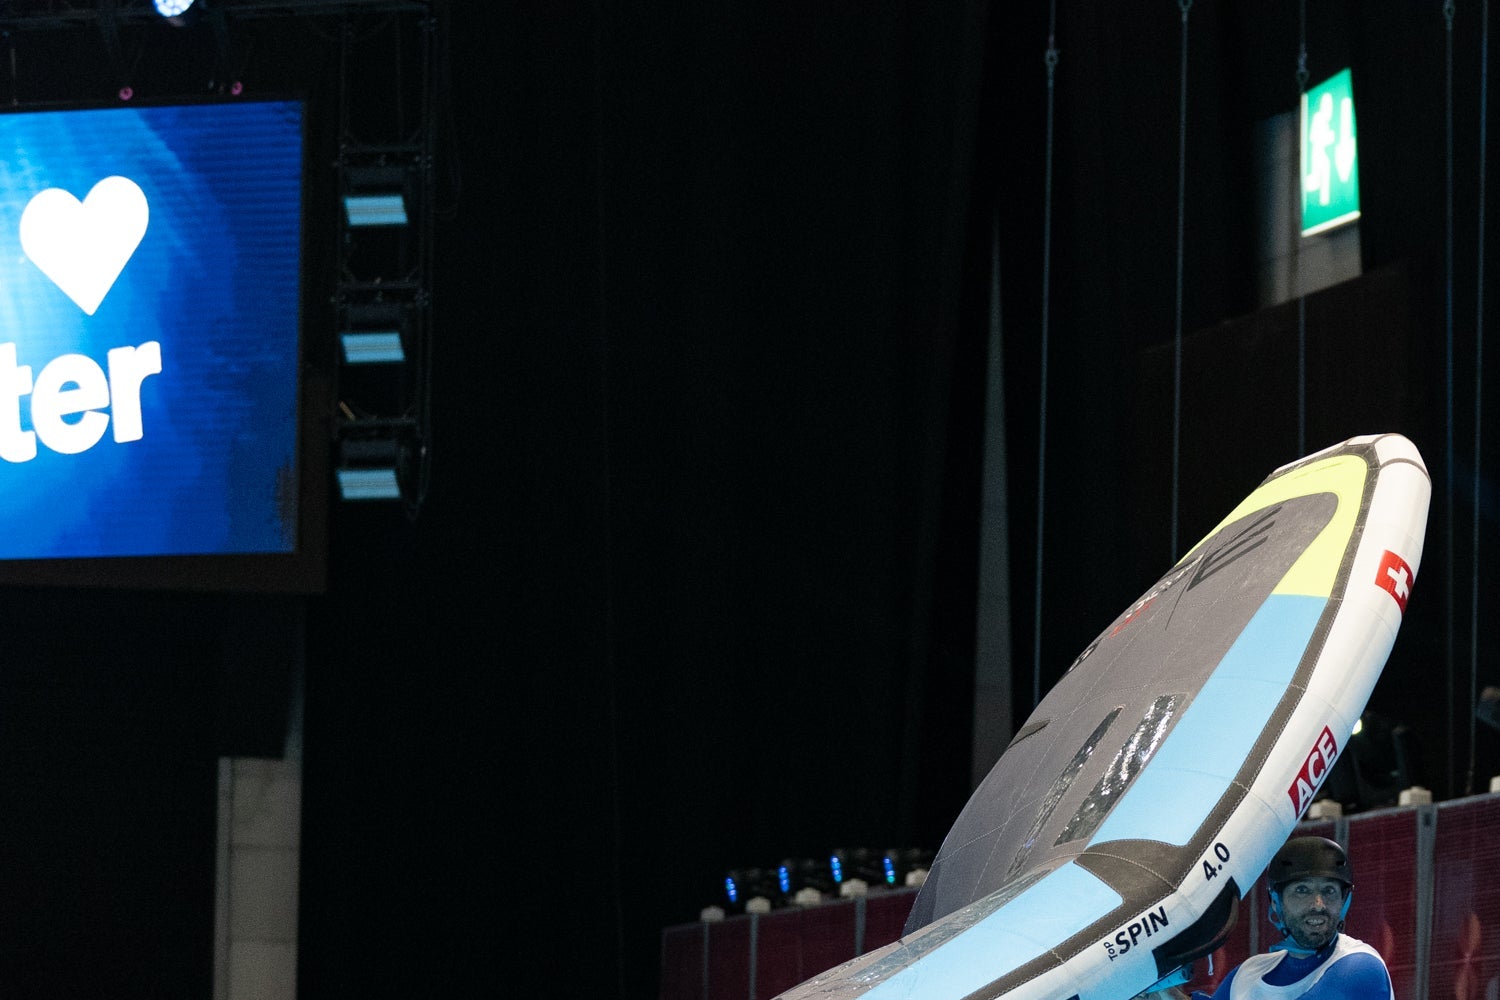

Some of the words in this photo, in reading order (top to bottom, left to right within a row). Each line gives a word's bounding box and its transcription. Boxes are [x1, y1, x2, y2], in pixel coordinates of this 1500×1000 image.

[0, 341, 162, 463] ter
[1296, 731, 1336, 815] ACE
[1114, 905, 1170, 955] SPIN
[1202, 842, 1231, 881] 4.0
